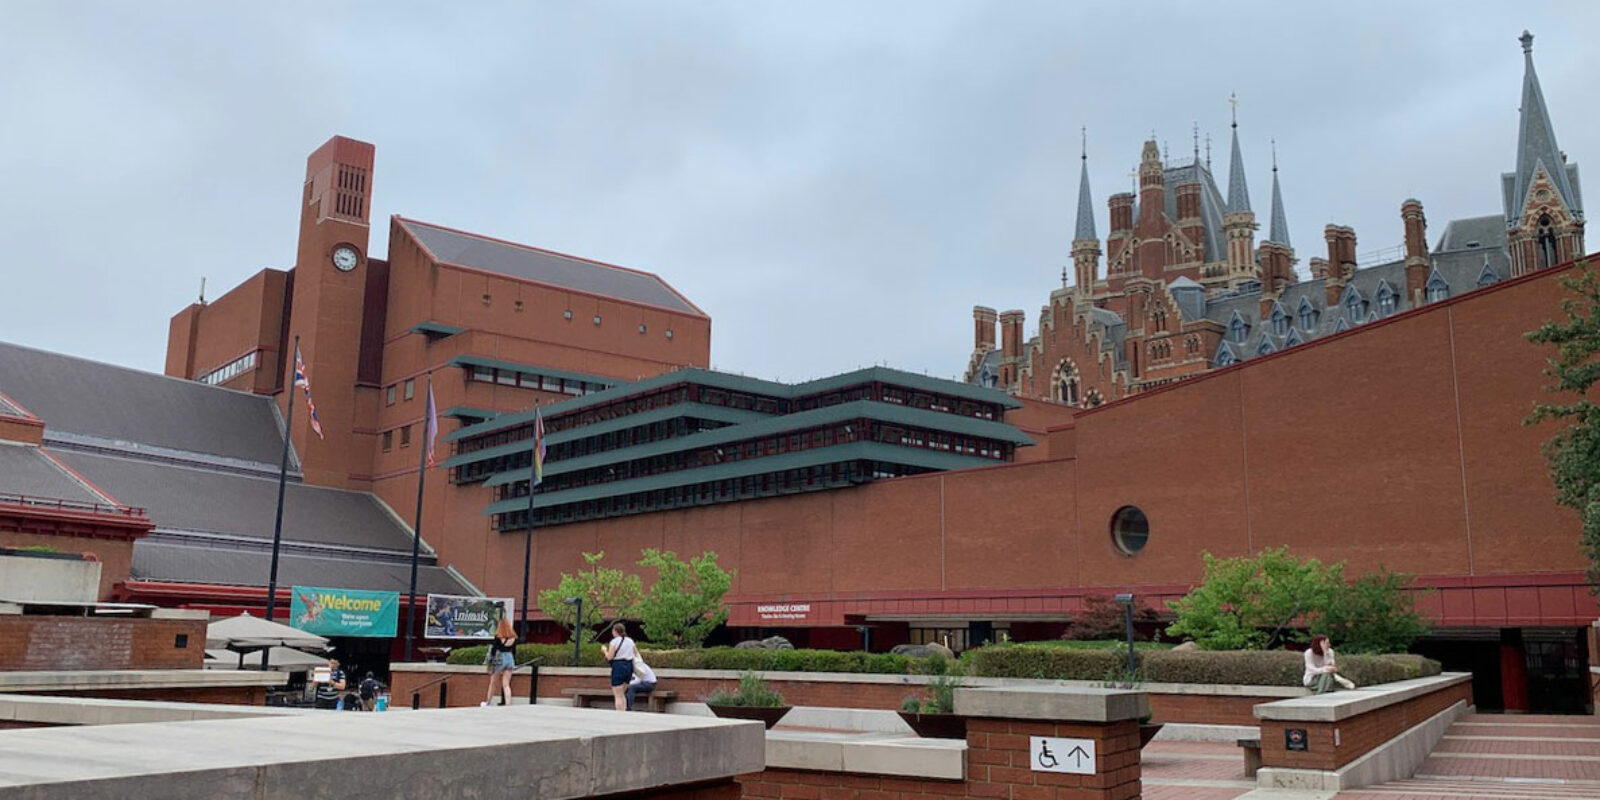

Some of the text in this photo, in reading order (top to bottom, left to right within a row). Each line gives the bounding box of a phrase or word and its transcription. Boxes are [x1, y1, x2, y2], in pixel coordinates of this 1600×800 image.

[318, 593, 381, 612] Welcome
[757, 604, 811, 613] KNOWLEDGE CENTRE
[451, 608, 489, 622] Animals
